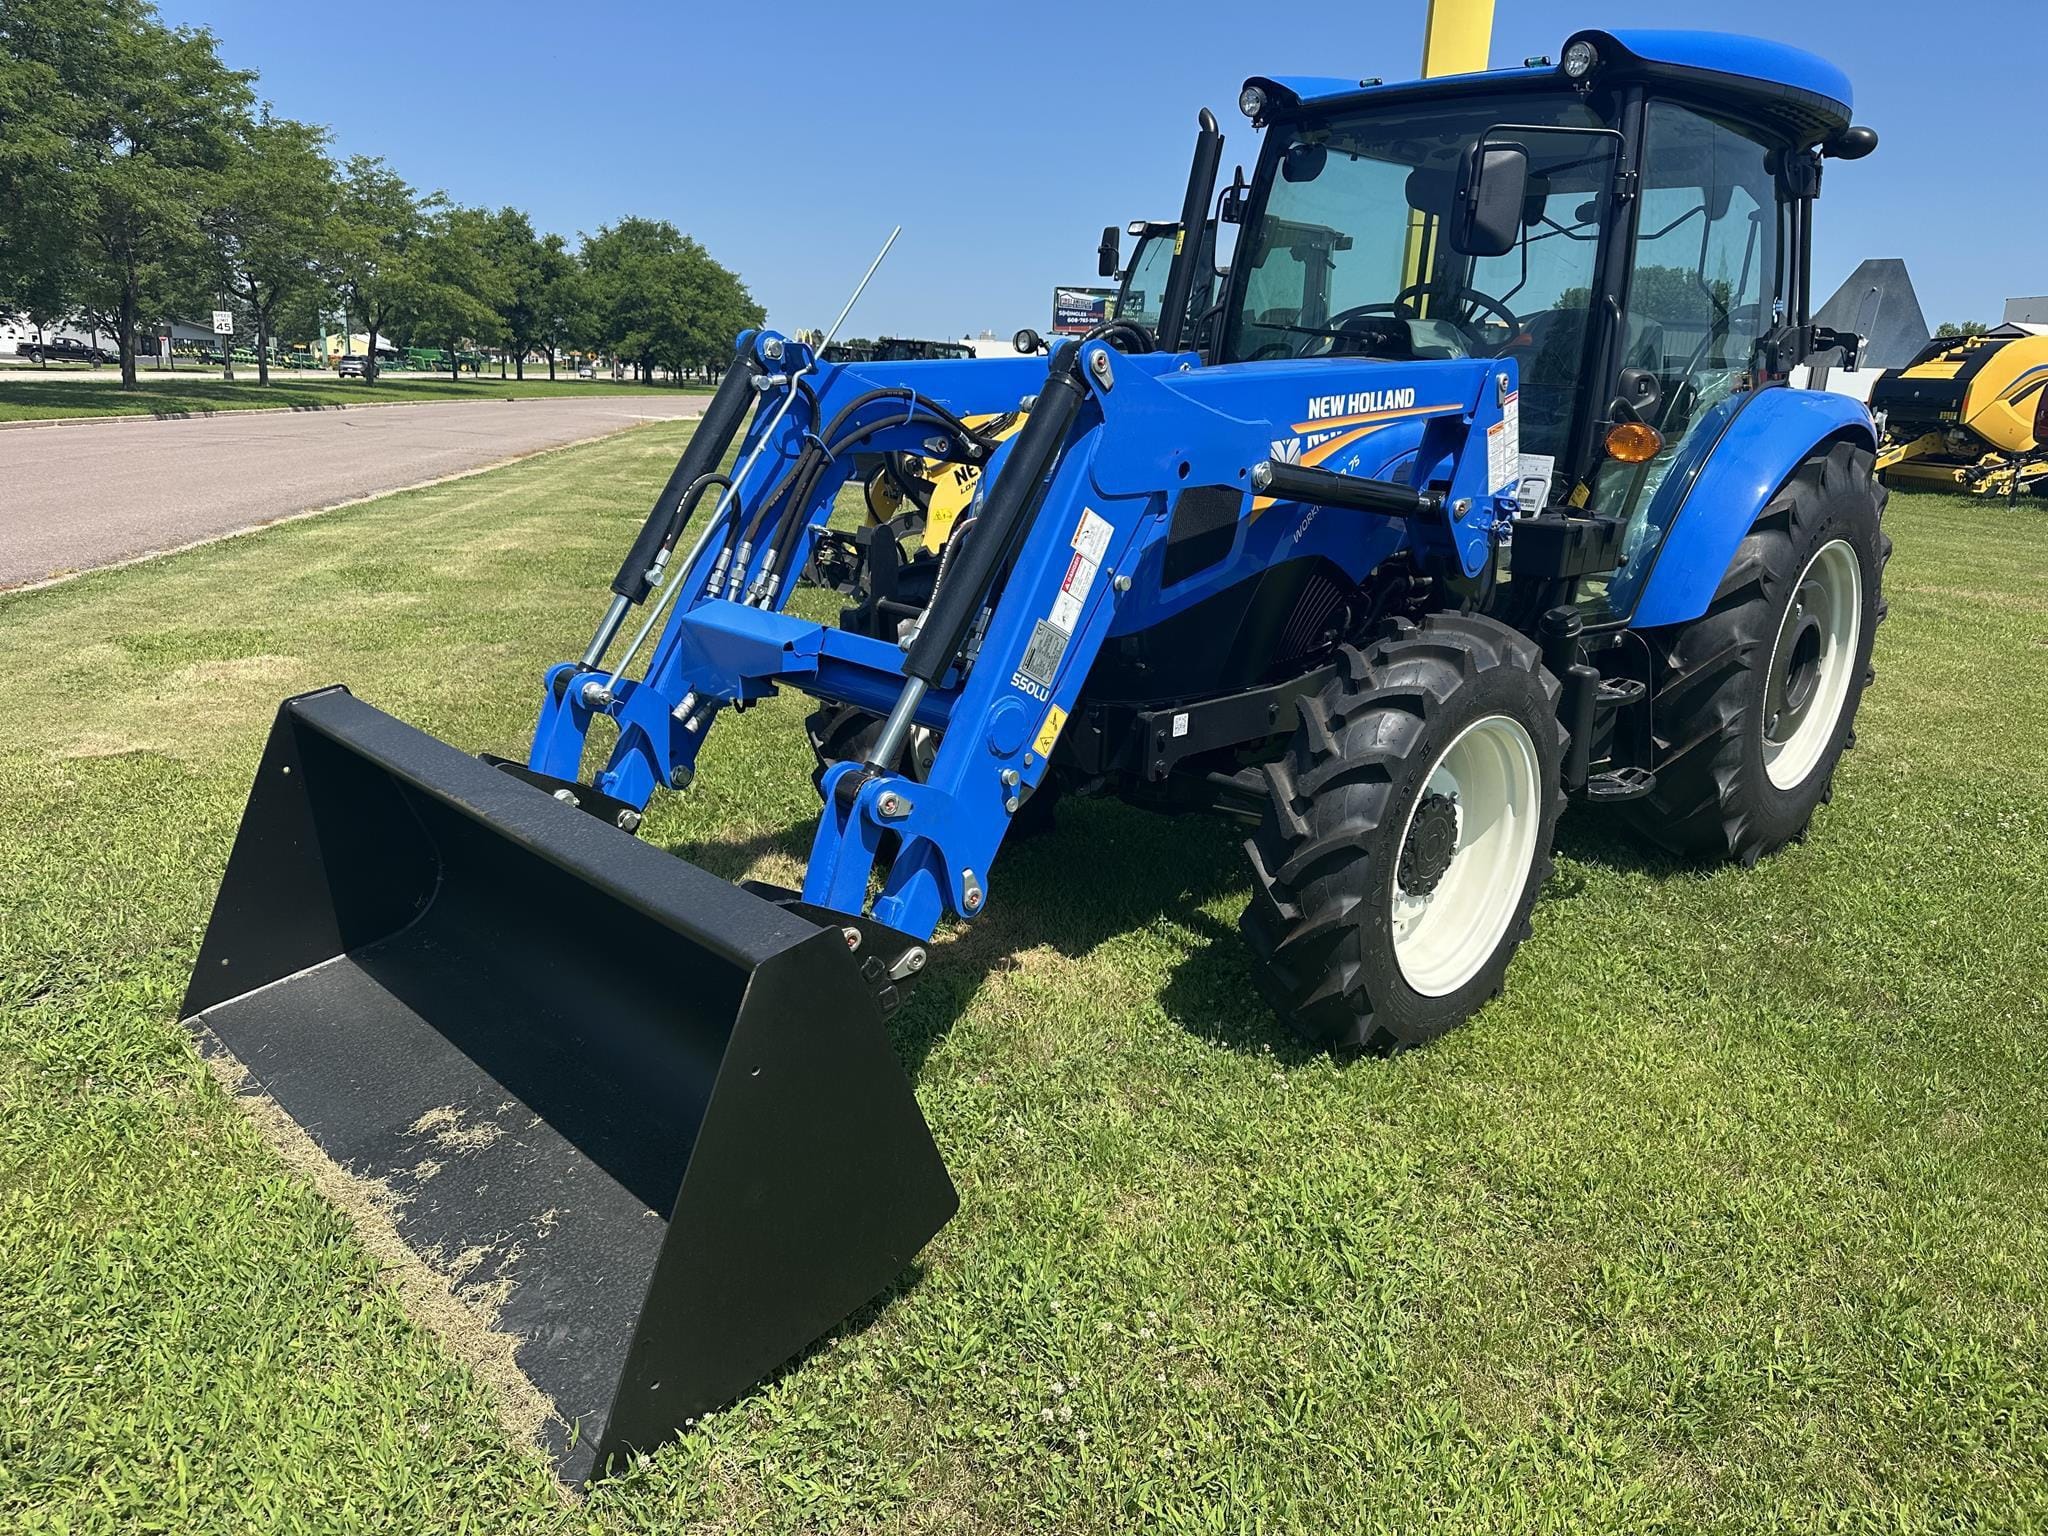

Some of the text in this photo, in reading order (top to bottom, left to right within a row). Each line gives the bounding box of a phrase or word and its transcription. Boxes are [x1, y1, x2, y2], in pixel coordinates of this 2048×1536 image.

[216, 323, 231, 331] 45
[1308, 387, 1415, 419] NEW HOLLAND
[1349, 454, 1360, 471] 75
[954, 465, 978, 486] NE
[960, 480, 977, 495] LON
[1011, 672, 1049, 702] 550LU
